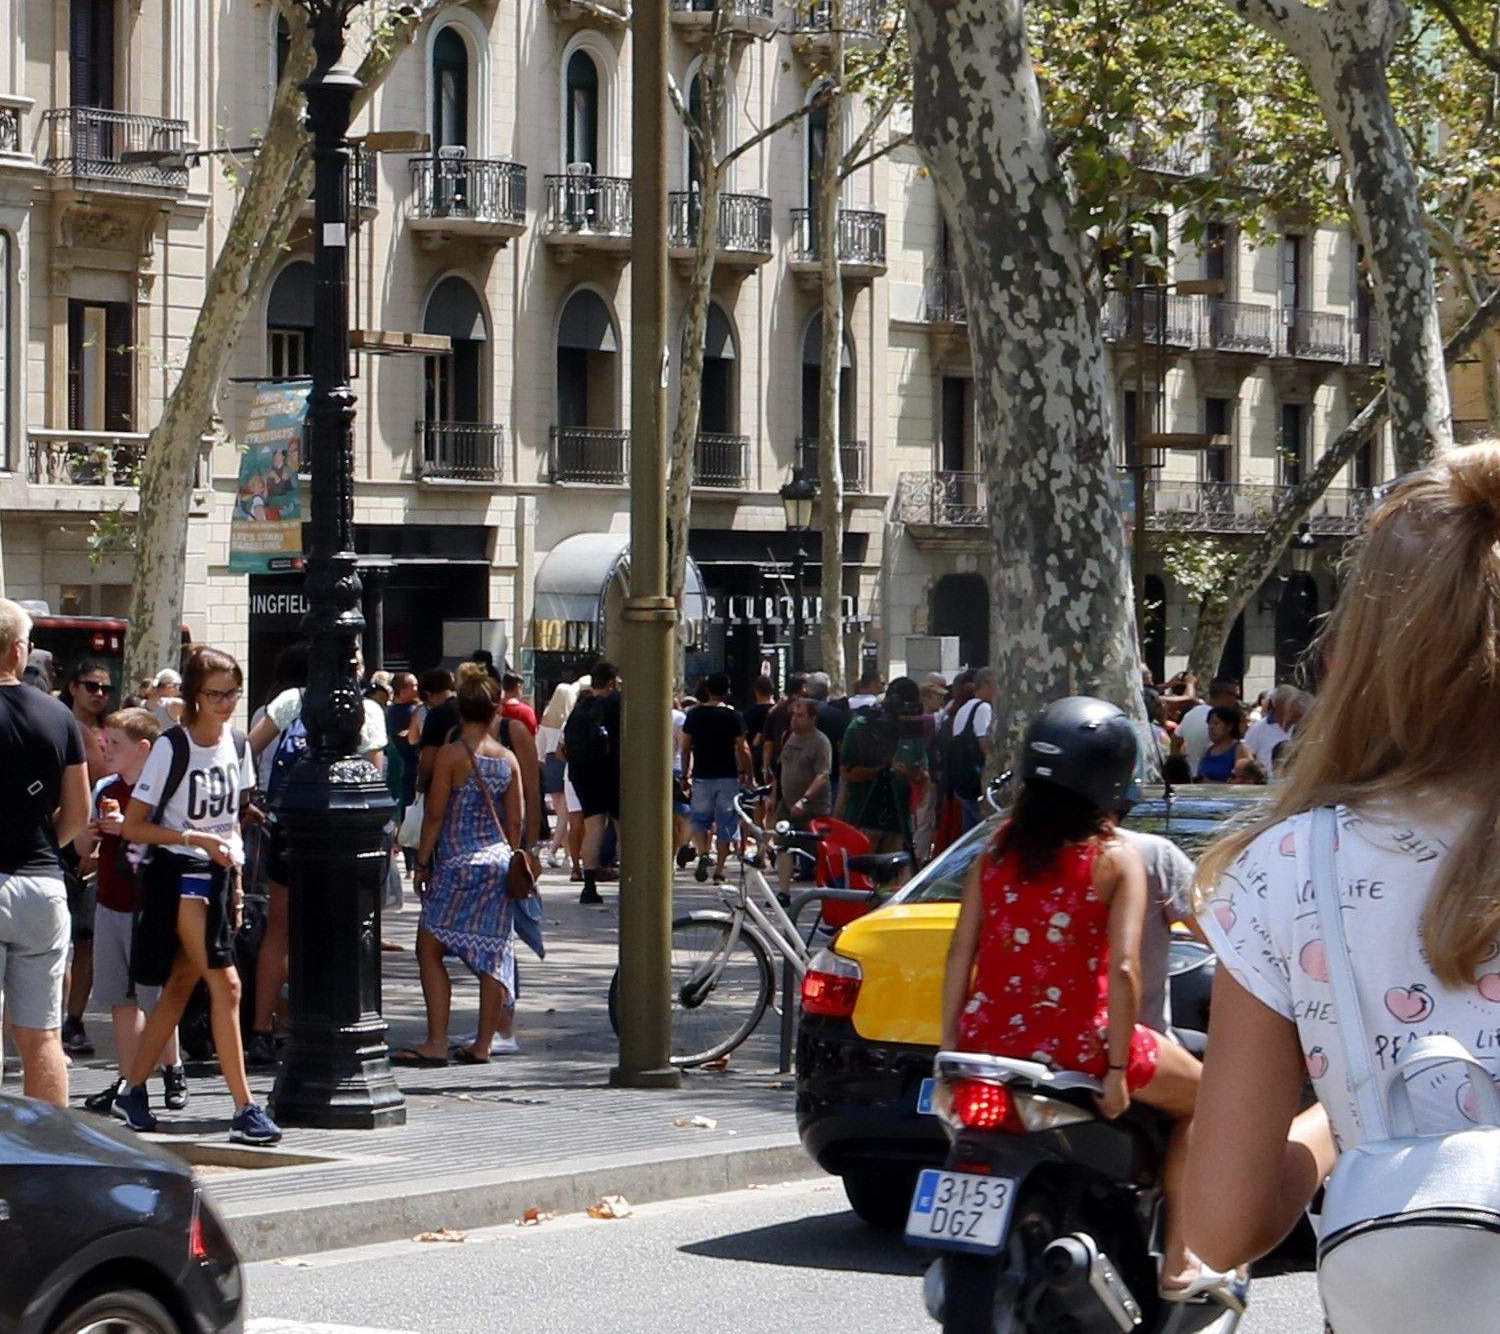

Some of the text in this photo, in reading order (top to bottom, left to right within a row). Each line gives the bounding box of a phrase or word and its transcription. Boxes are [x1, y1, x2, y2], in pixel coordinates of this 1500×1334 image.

[248, 594, 311, 614] INGFIEL
[938, 1178, 1008, 1210] 3153
[930, 1206, 984, 1238] DGZ
